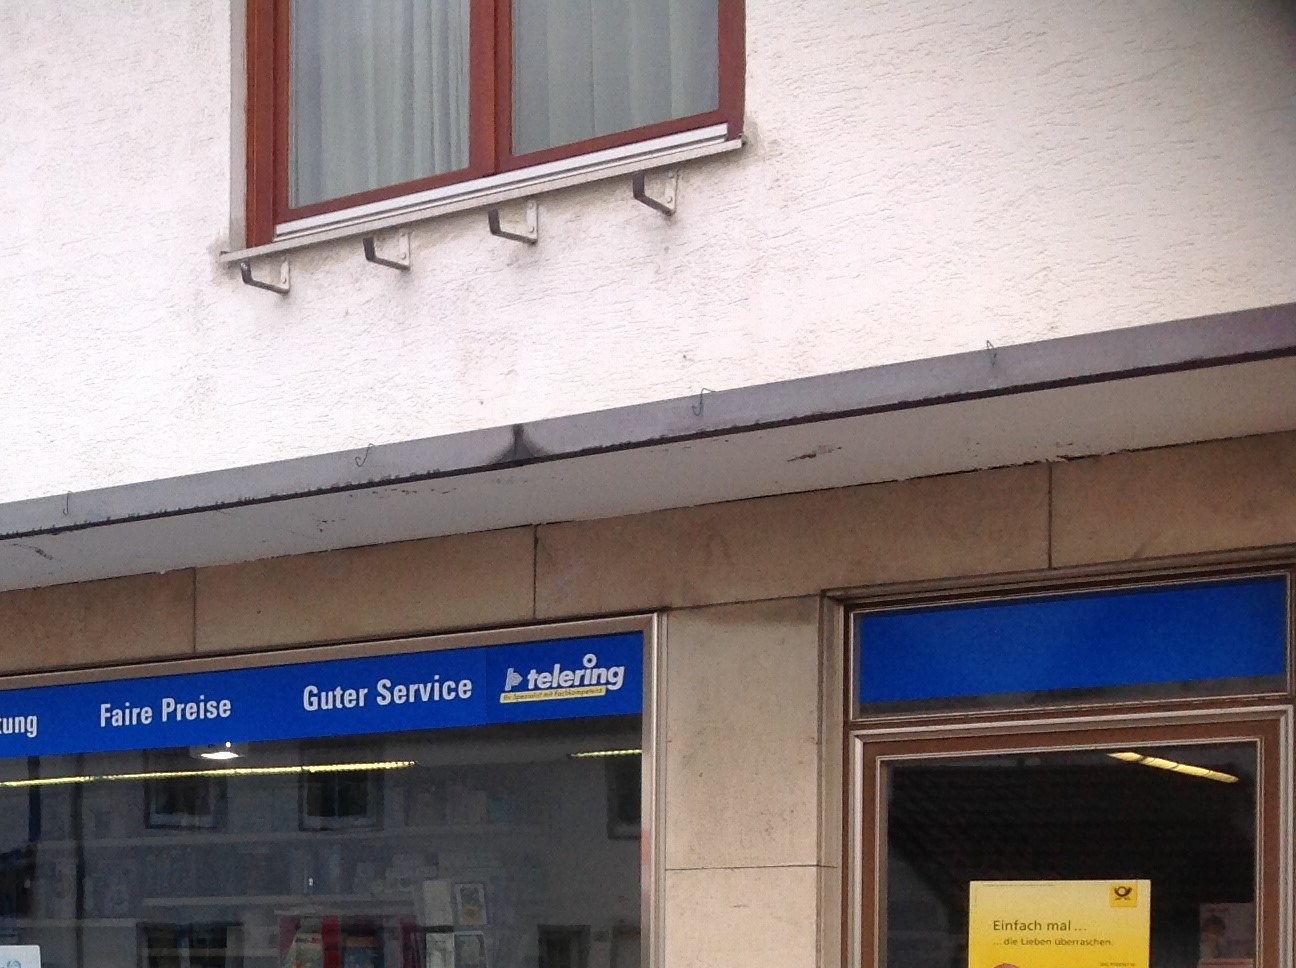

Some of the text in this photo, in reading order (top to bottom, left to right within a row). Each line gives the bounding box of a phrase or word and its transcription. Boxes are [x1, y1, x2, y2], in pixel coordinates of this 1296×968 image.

[527, 653, 625, 690] telering
[303, 674, 473, 713] Guter Service
[100, 694, 232, 727] Faire Preise
[993, 920, 1042, 931] Einfach
[1047, 920, 1071, 931] mal
[1004, 937, 1018, 946] die
[1021, 937, 1052, 946] Lieben
